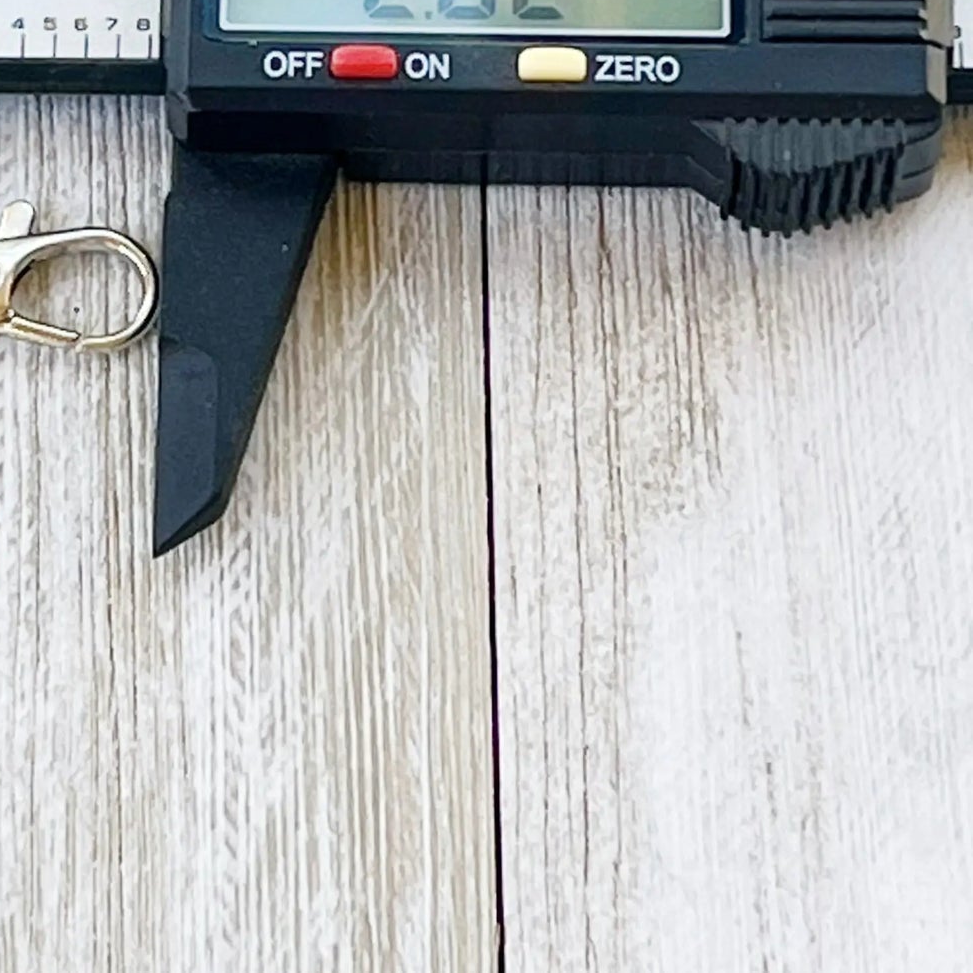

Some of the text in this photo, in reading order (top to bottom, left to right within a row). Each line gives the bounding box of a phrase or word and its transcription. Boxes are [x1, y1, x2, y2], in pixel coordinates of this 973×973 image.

[12, 18, 24, 30] 4
[43, 17, 57, 31] 5
[74, 18, 88, 31] 6
[106, 18, 118, 31] 7
[136, 18, 150, 31] 8
[263, 50, 324, 78] OFF
[404, 52, 451, 80] ON
[594, 55, 680, 83] ZERO
